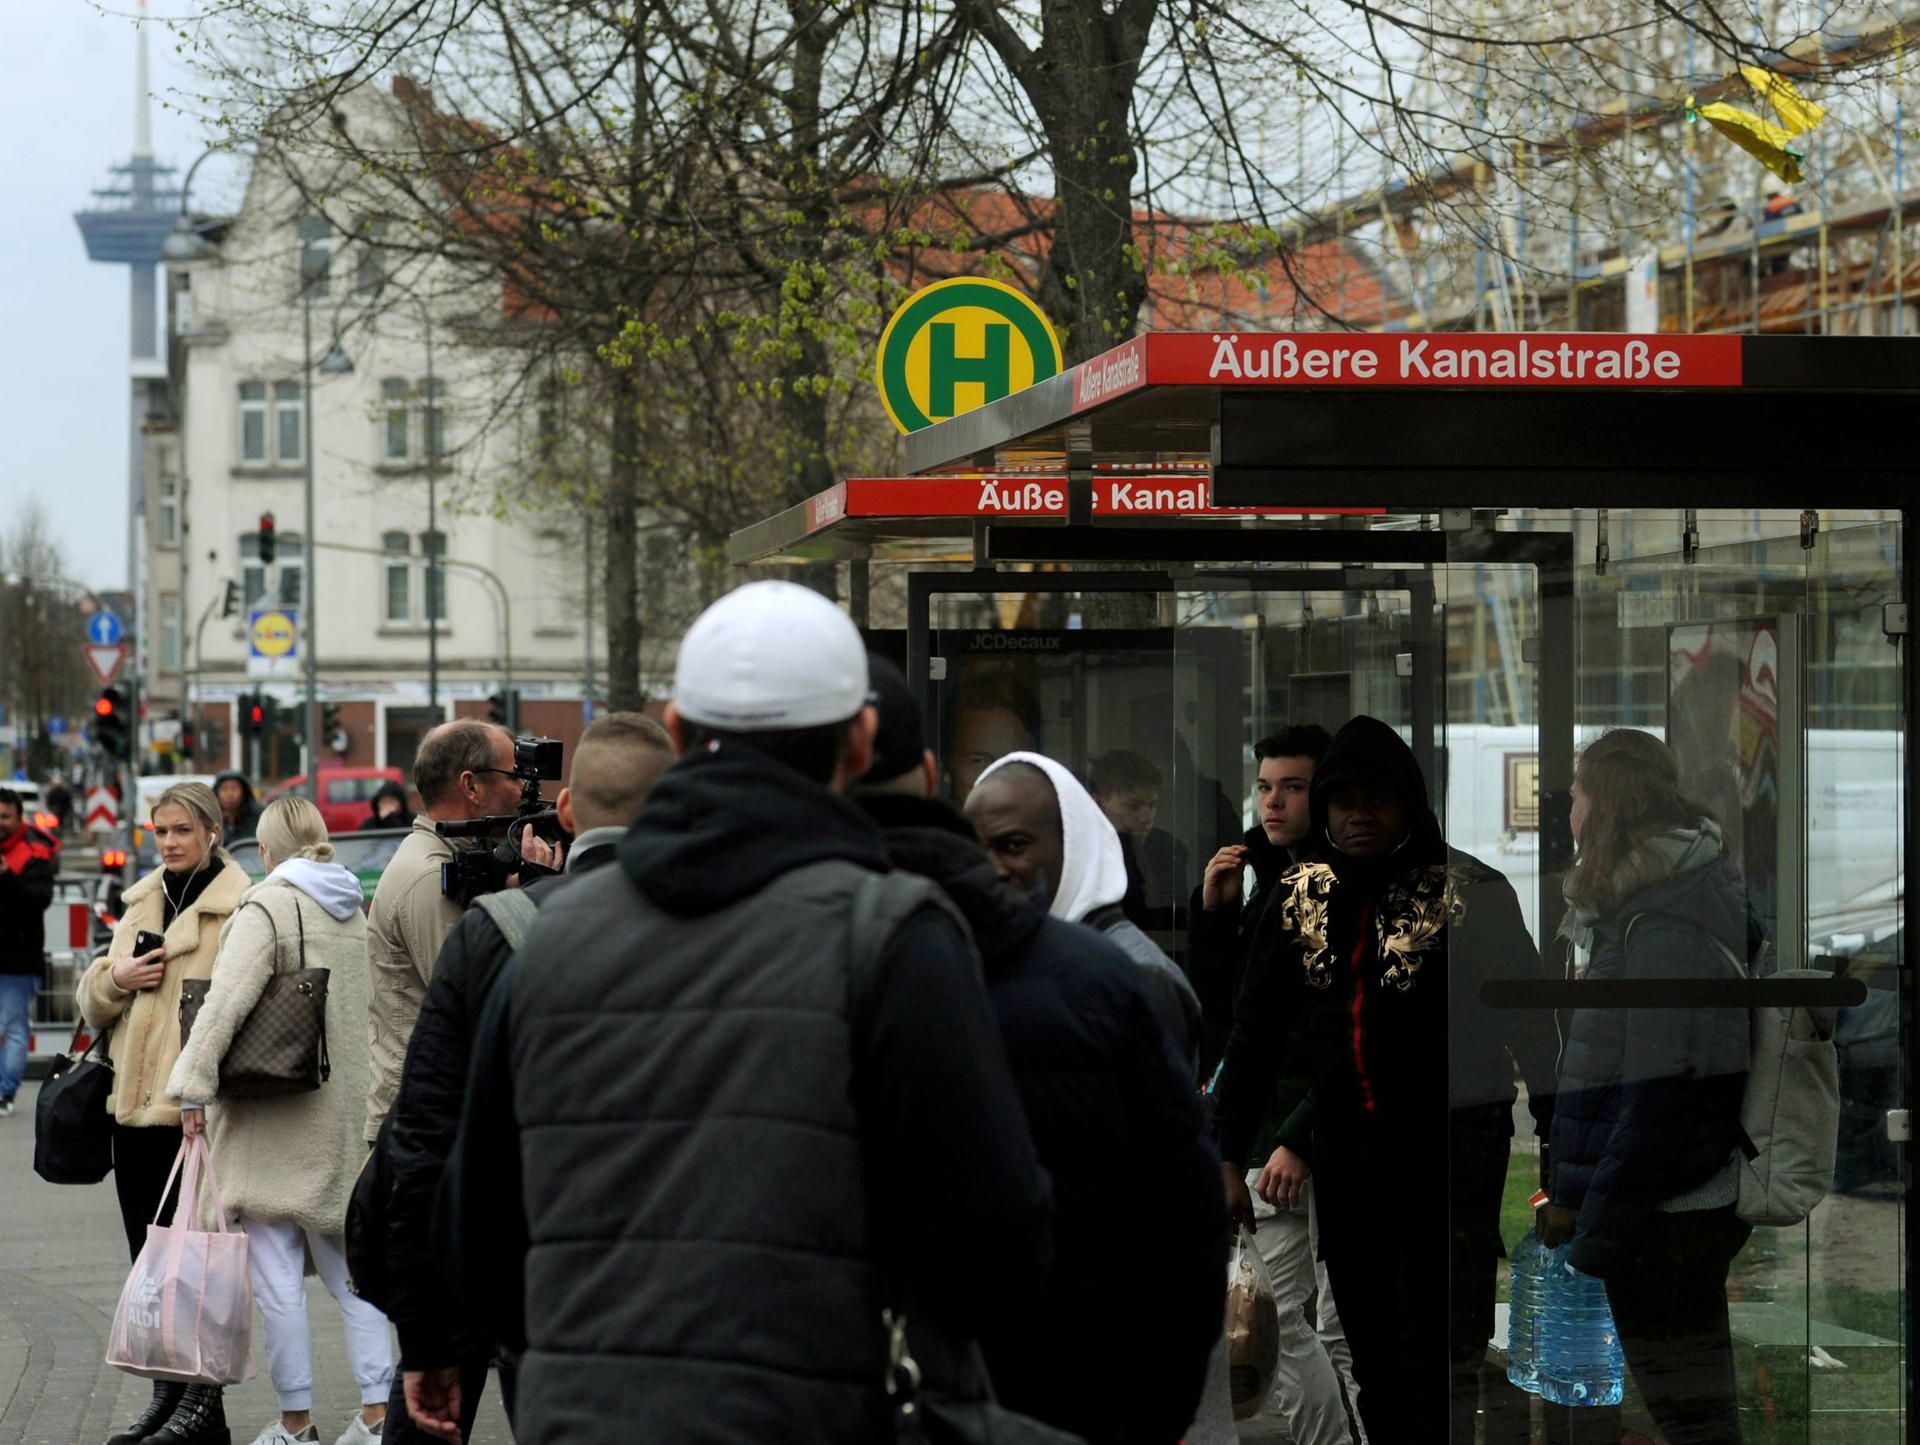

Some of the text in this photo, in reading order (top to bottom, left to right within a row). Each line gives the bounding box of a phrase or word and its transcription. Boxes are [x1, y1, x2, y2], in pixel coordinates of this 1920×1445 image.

[929, 323, 1010, 417] H
[1209, 334, 1681, 379] Äußere Kanalstraße
[977, 479, 1099, 510] Äuße
[969, 633, 1061, 650] JCDecaux
